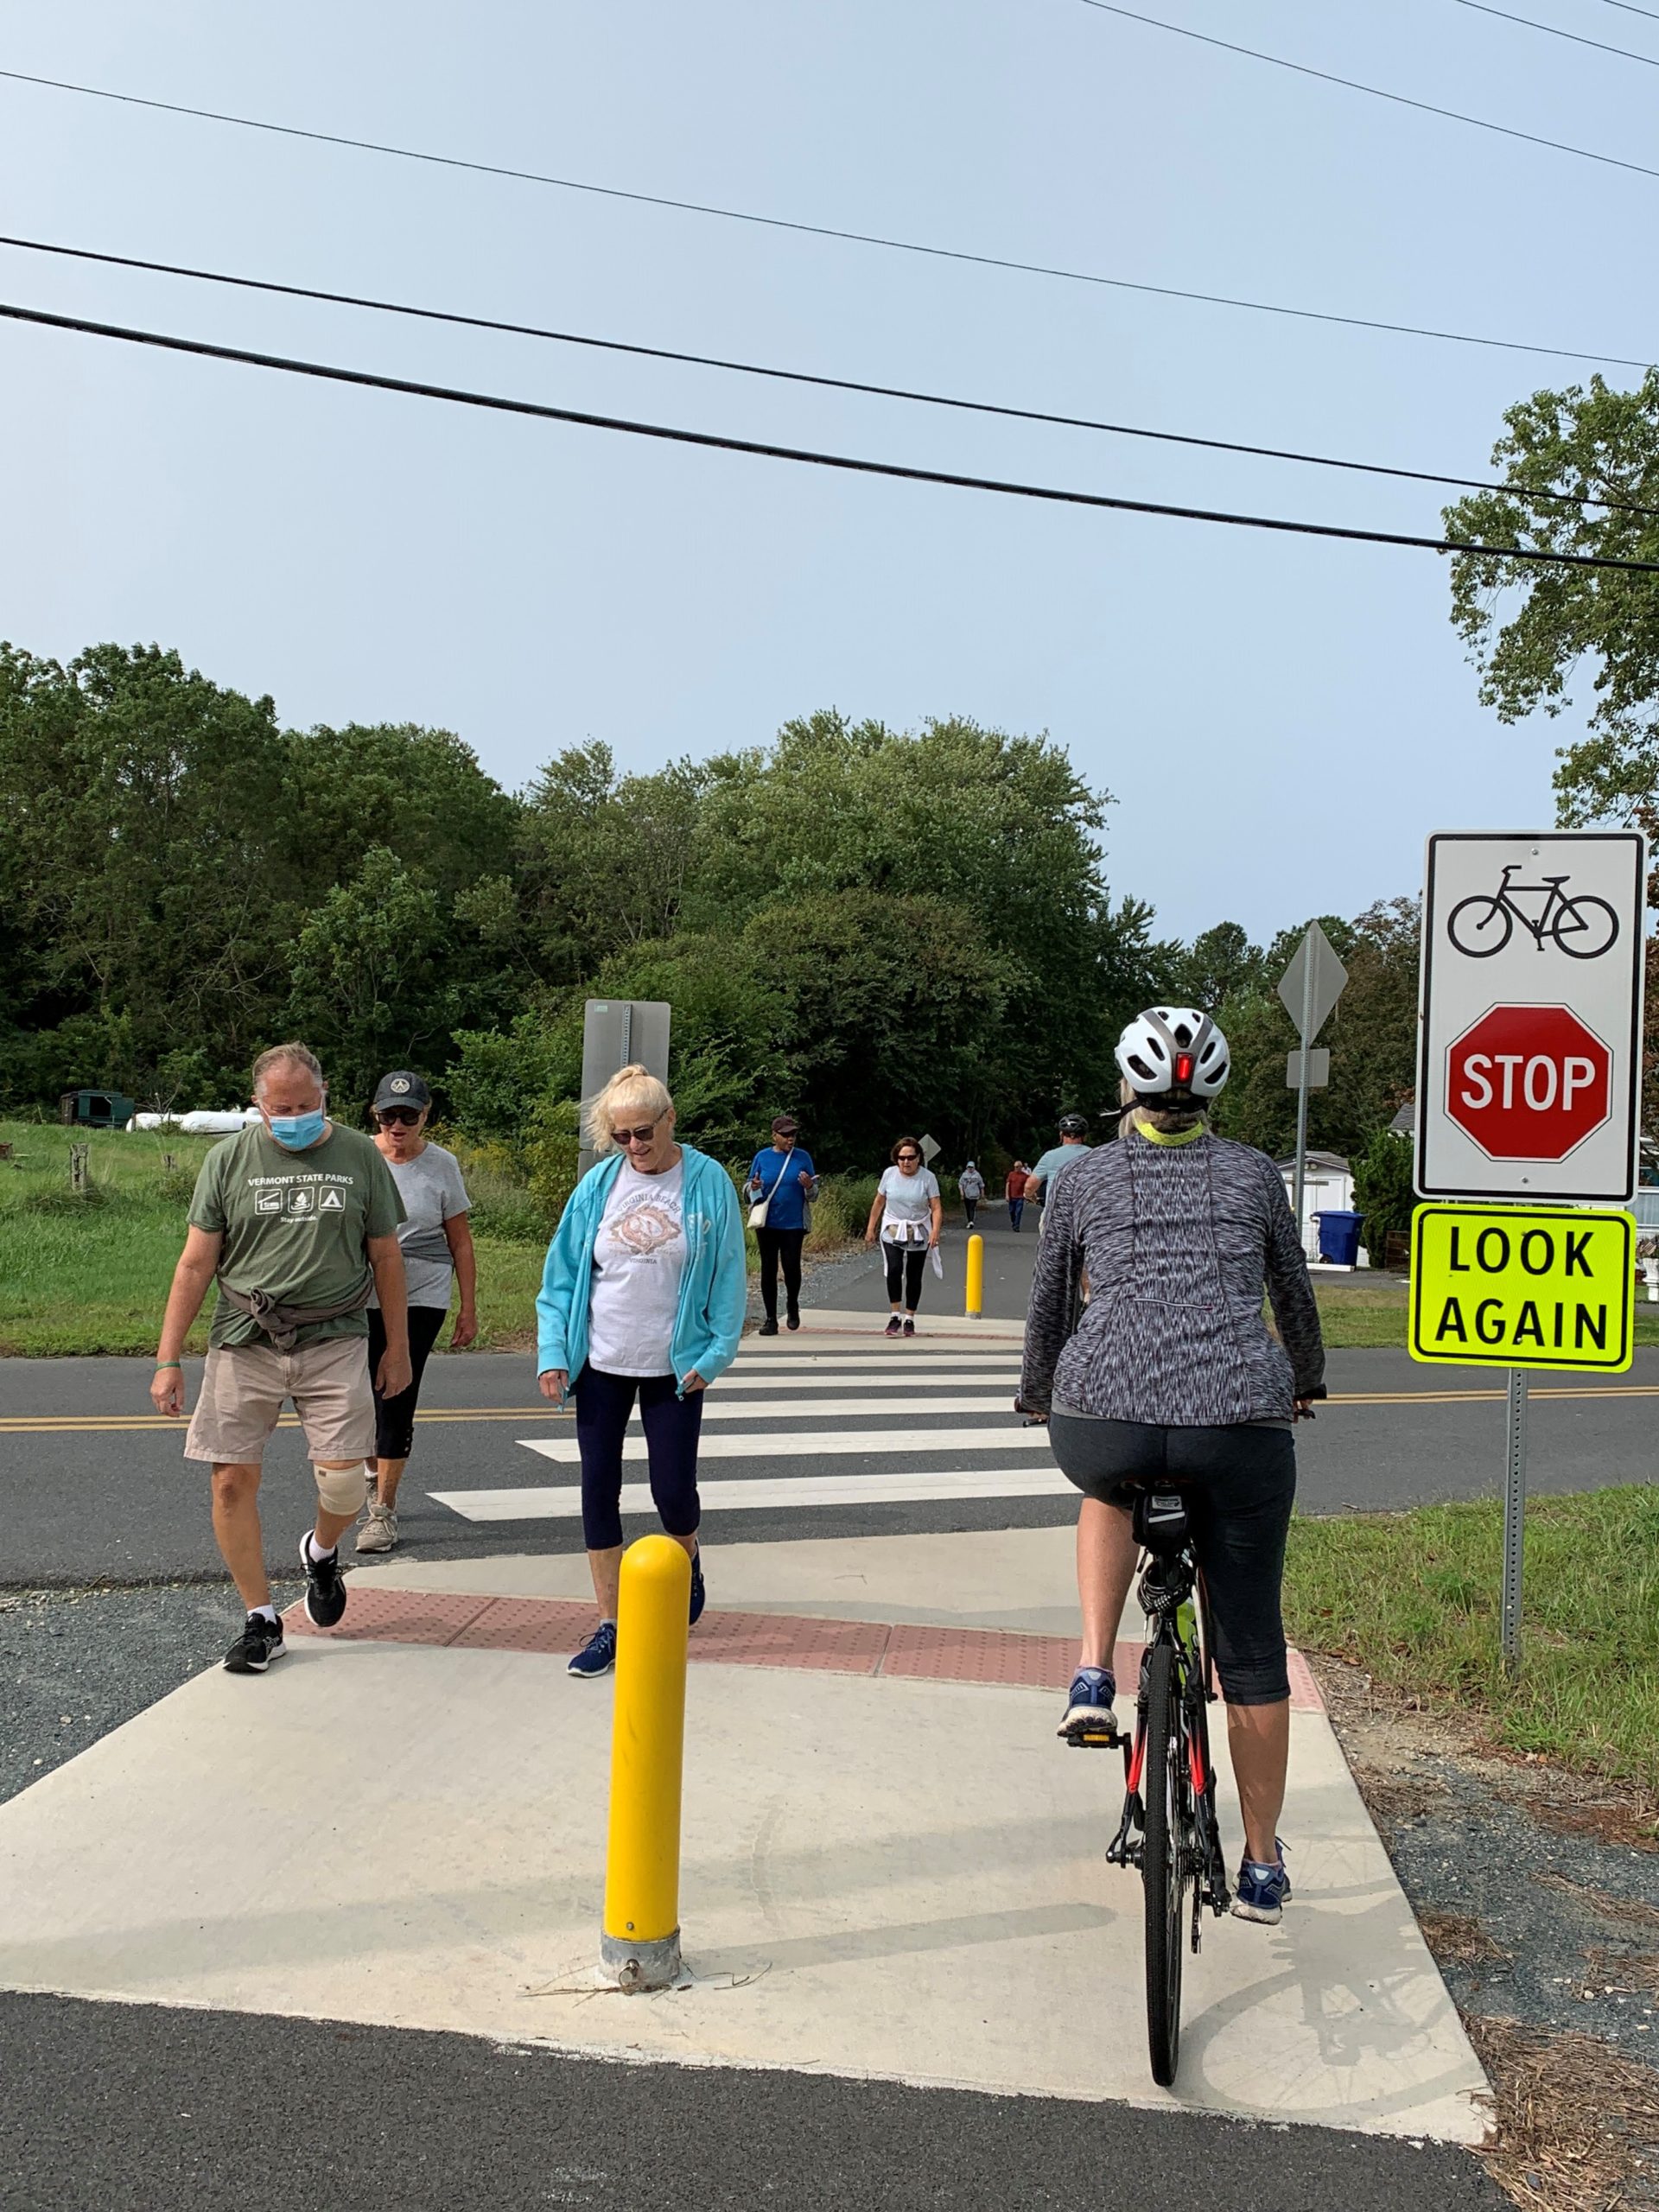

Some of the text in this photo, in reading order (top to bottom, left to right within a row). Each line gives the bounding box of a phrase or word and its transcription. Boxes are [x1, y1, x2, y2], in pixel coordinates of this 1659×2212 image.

[1460, 1053, 1596, 1111] STOP
[248, 1173, 353, 1186] VERMONT STATE PARKS
[619, 1193, 681, 1214] VIRGINIA BEACH
[1449, 1226, 1594, 1278] LOOK
[1435, 1296, 1607, 1350] AGAIN
